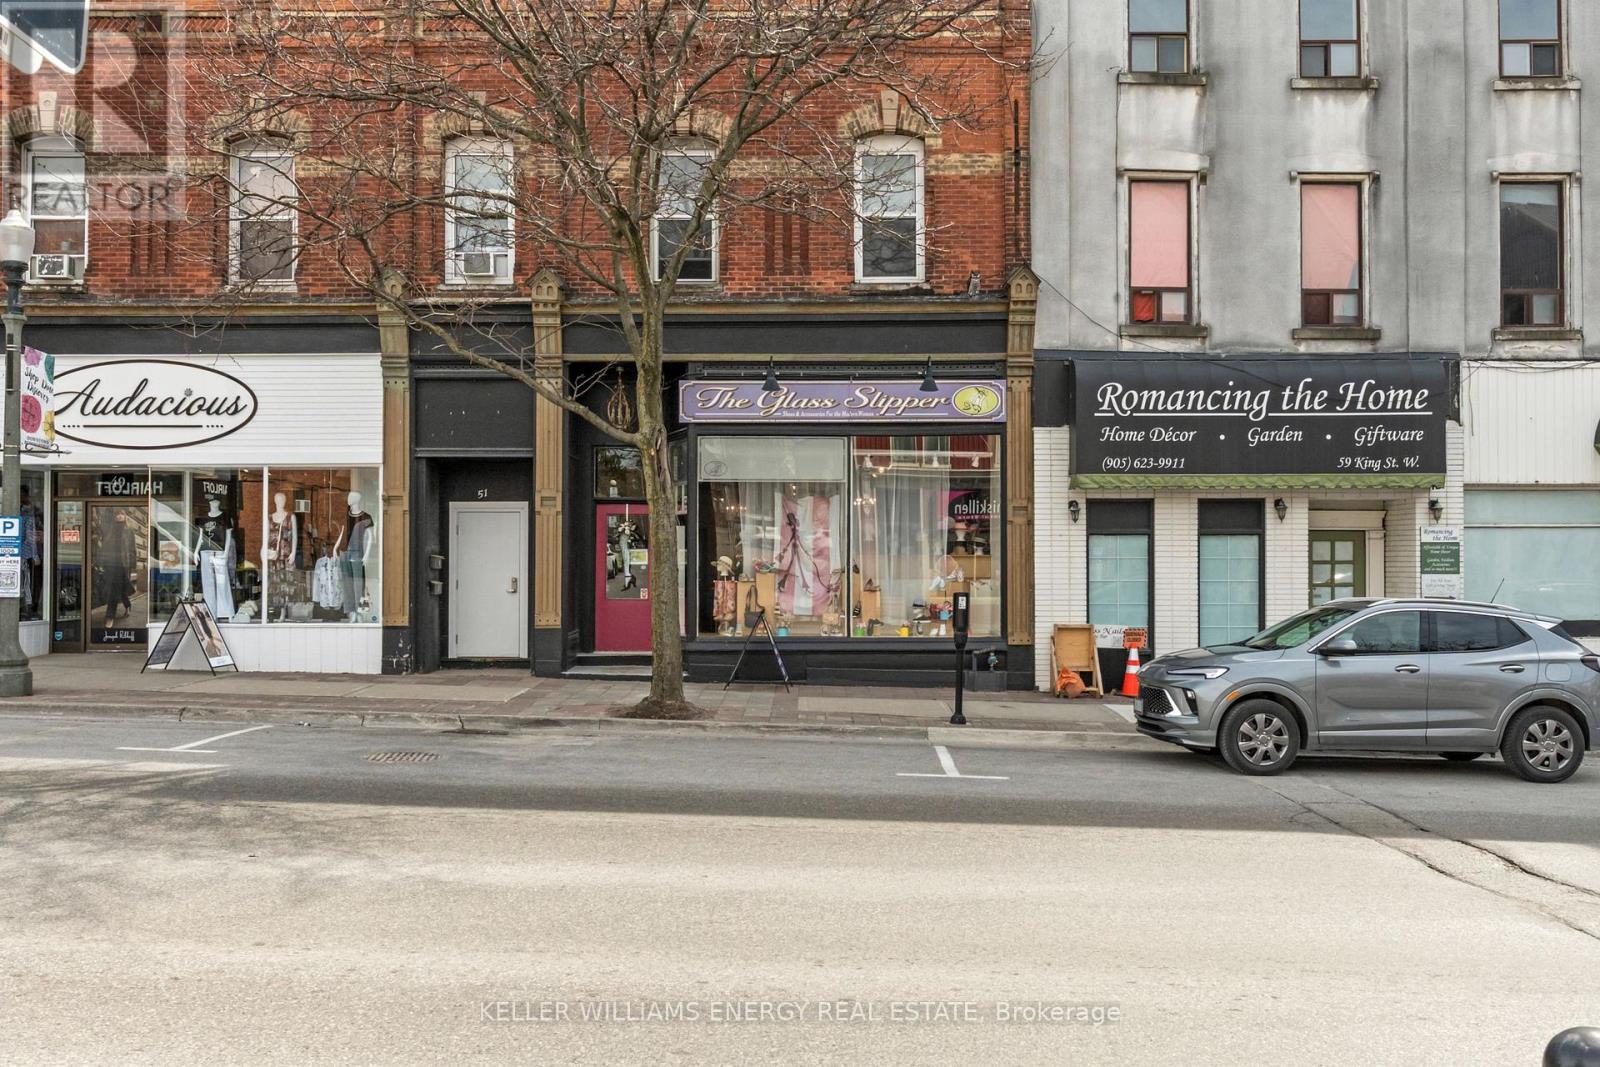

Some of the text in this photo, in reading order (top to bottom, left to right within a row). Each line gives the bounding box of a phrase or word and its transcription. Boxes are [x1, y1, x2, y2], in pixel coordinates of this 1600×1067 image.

[54, 378, 248, 417] Audacious
[696, 384, 952, 417] The Glass Slipper
[1096, 378, 1429, 421] Romancing the Home
[1100, 424, 1197, 442] Home Décor
[1247, 426, 1303, 447] Garden
[1354, 424, 1424, 447] Giftware
[1102, 456, 1185, 472] (905) 623-9911
[1336, 455, 1420, 471] 59 King St. W.
[477, 488, 488, 499] 51
[3, 521, 15, 534] P
[1103, 627, 1123, 635] Nail
